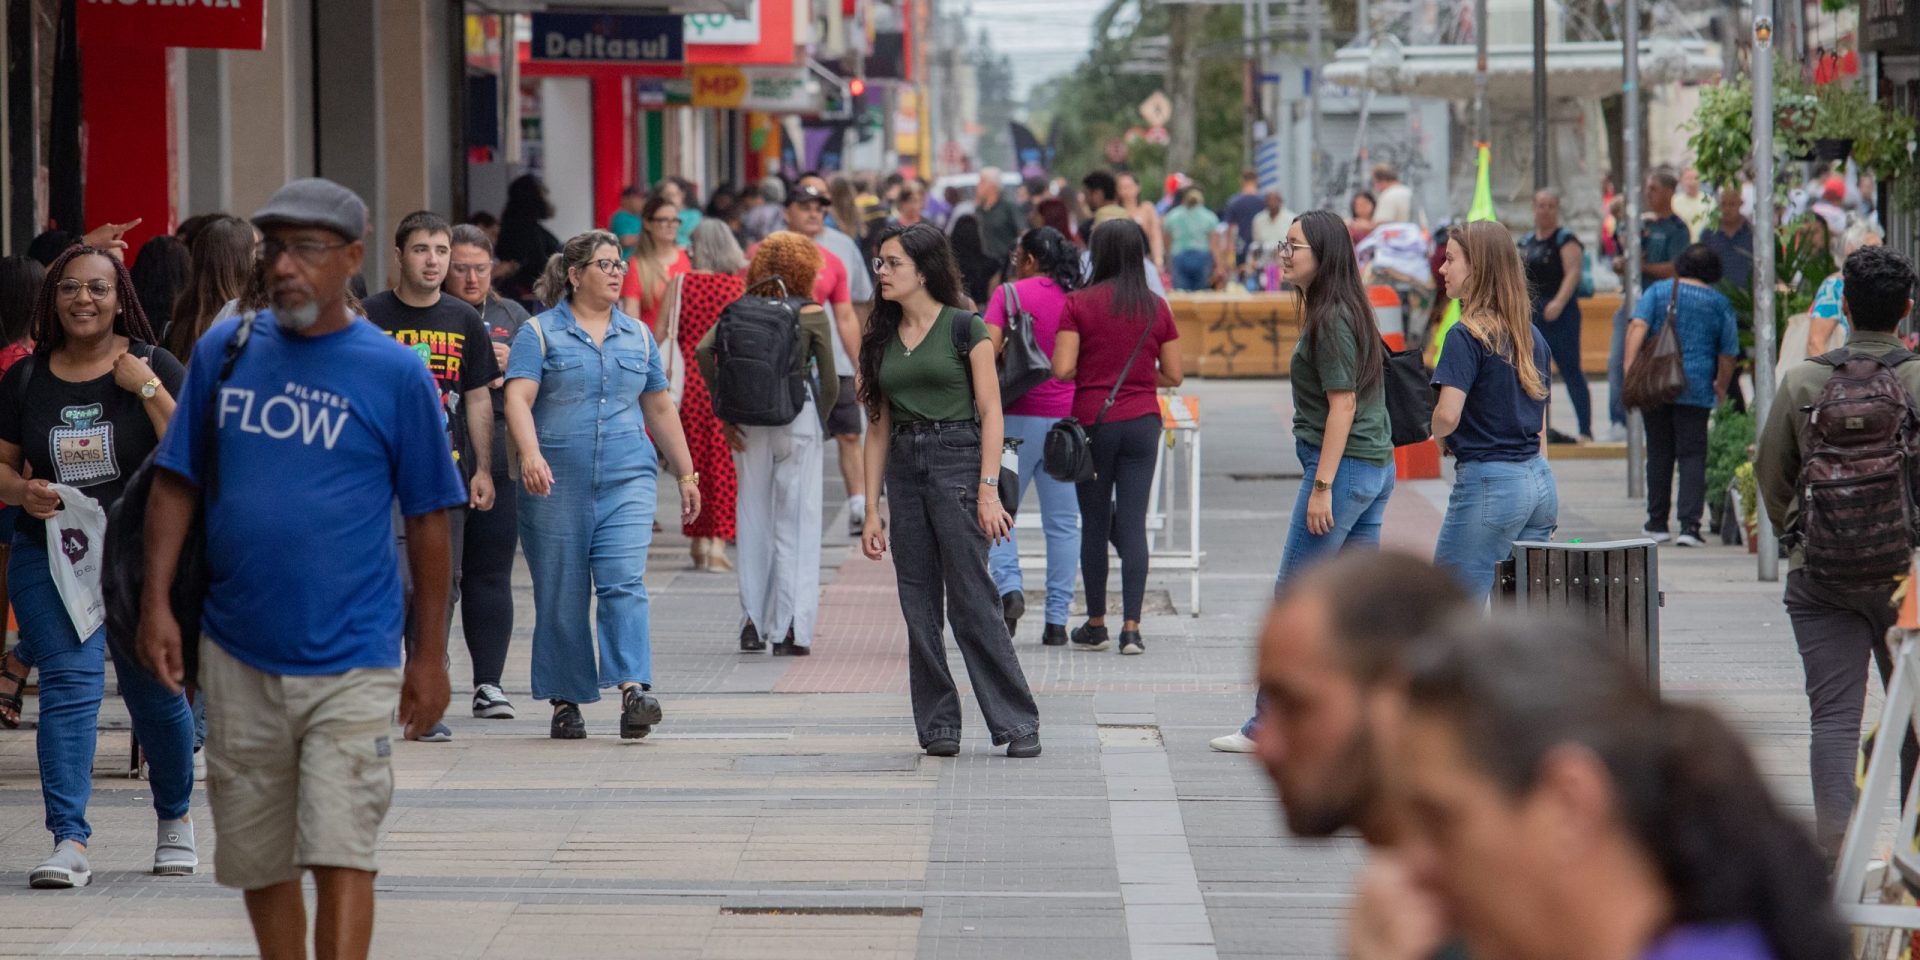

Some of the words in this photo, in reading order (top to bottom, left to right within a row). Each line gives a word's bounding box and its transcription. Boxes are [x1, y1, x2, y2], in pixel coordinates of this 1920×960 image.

[545, 32, 669, 59] Deltasul
[698, 74, 740, 97] MP
[284, 381, 351, 410] PILATES
[218, 387, 350, 451] FLOW
[63, 449, 101, 461] PARIS
